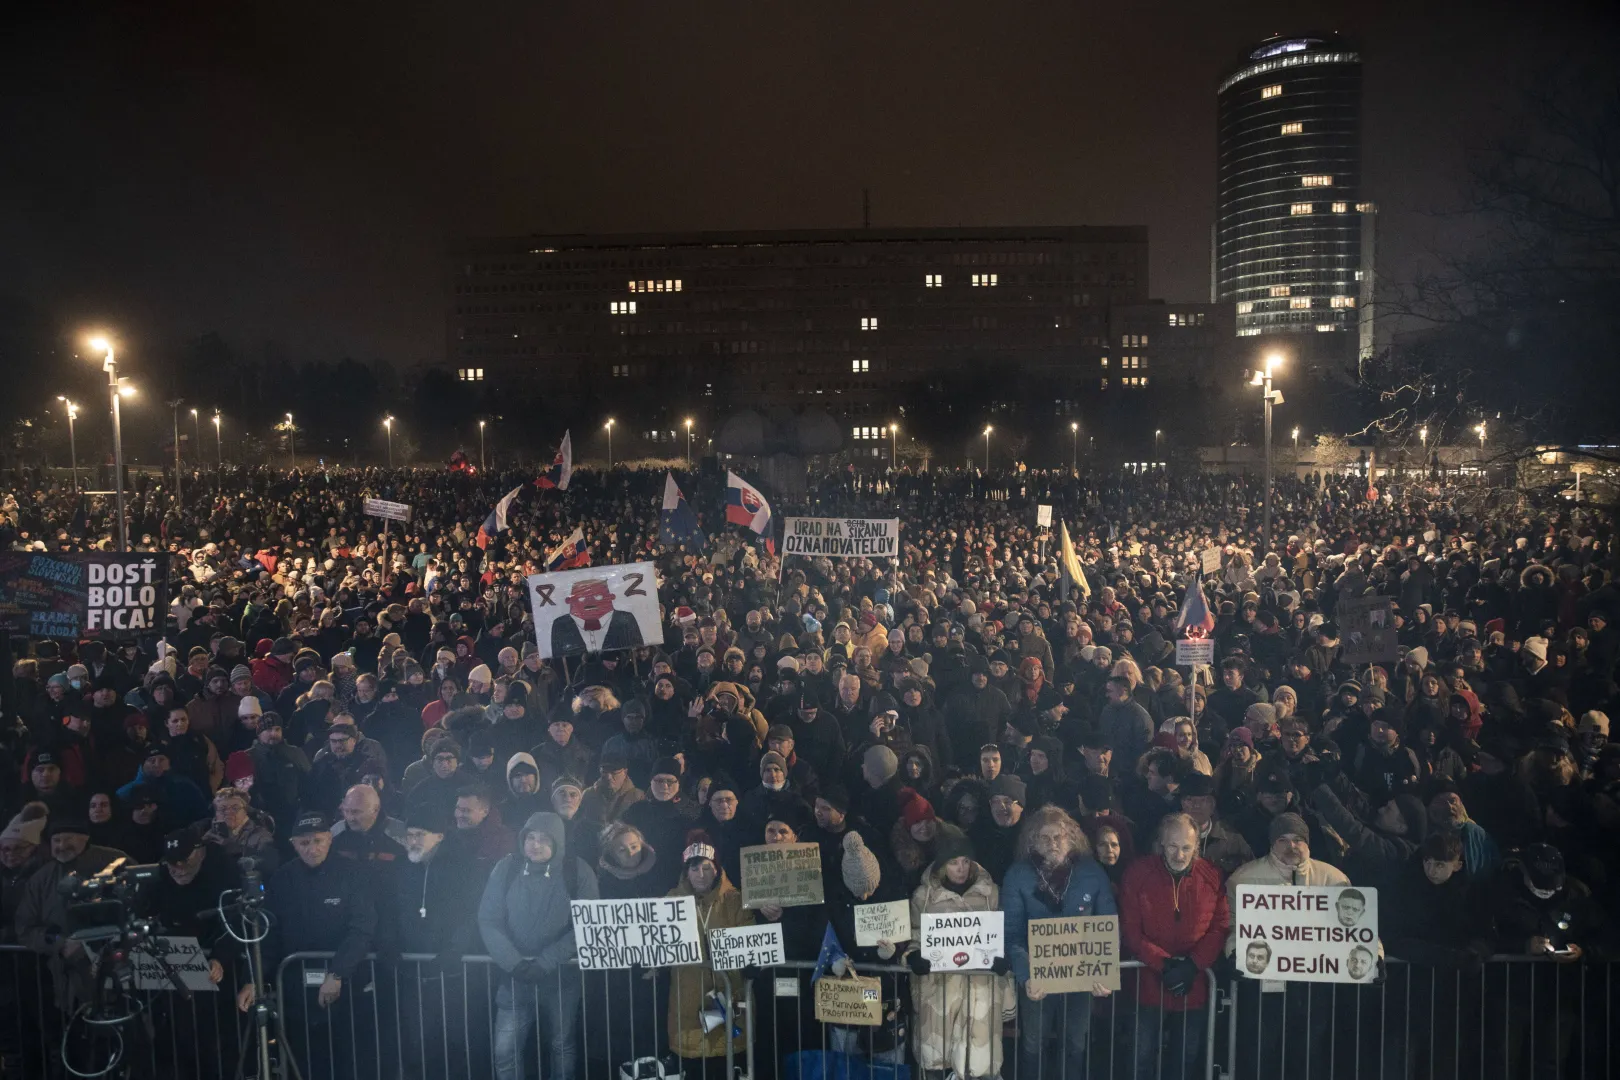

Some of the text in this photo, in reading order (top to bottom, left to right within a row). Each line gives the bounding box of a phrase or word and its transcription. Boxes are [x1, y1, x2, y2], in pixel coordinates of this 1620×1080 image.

[794, 519, 822, 536] ÚRAD
[827, 521, 842, 536] NA
[88, 558, 156, 584] DOSŤ
[88, 586, 156, 607] BOLO
[87, 607, 155, 630] FICA!
[744, 850, 783, 864] TREBA
[1242, 890, 1329, 911] PATRÍTE
[571, 900, 687, 925] POLITIKA NIE JE
[928, 916, 981, 932] „BANDA
[1031, 922, 1079, 936] PODLIAK
[1239, 924, 1374, 943] NA SMETISKO
[639, 924, 682, 946] PRED
[711, 932, 778, 950] VLÁDA KRYJE
[926, 931, 982, 948] ŠPINAVÁ
[712, 949, 729, 958] TAM
[714, 949, 779, 970] MAFIA ŽIJE
[1033, 941, 1113, 959] DEMONTUJE
[1033, 959, 1112, 979] PRÁVNY ŠTÁT
[1277, 954, 1339, 974] DEJÍN
